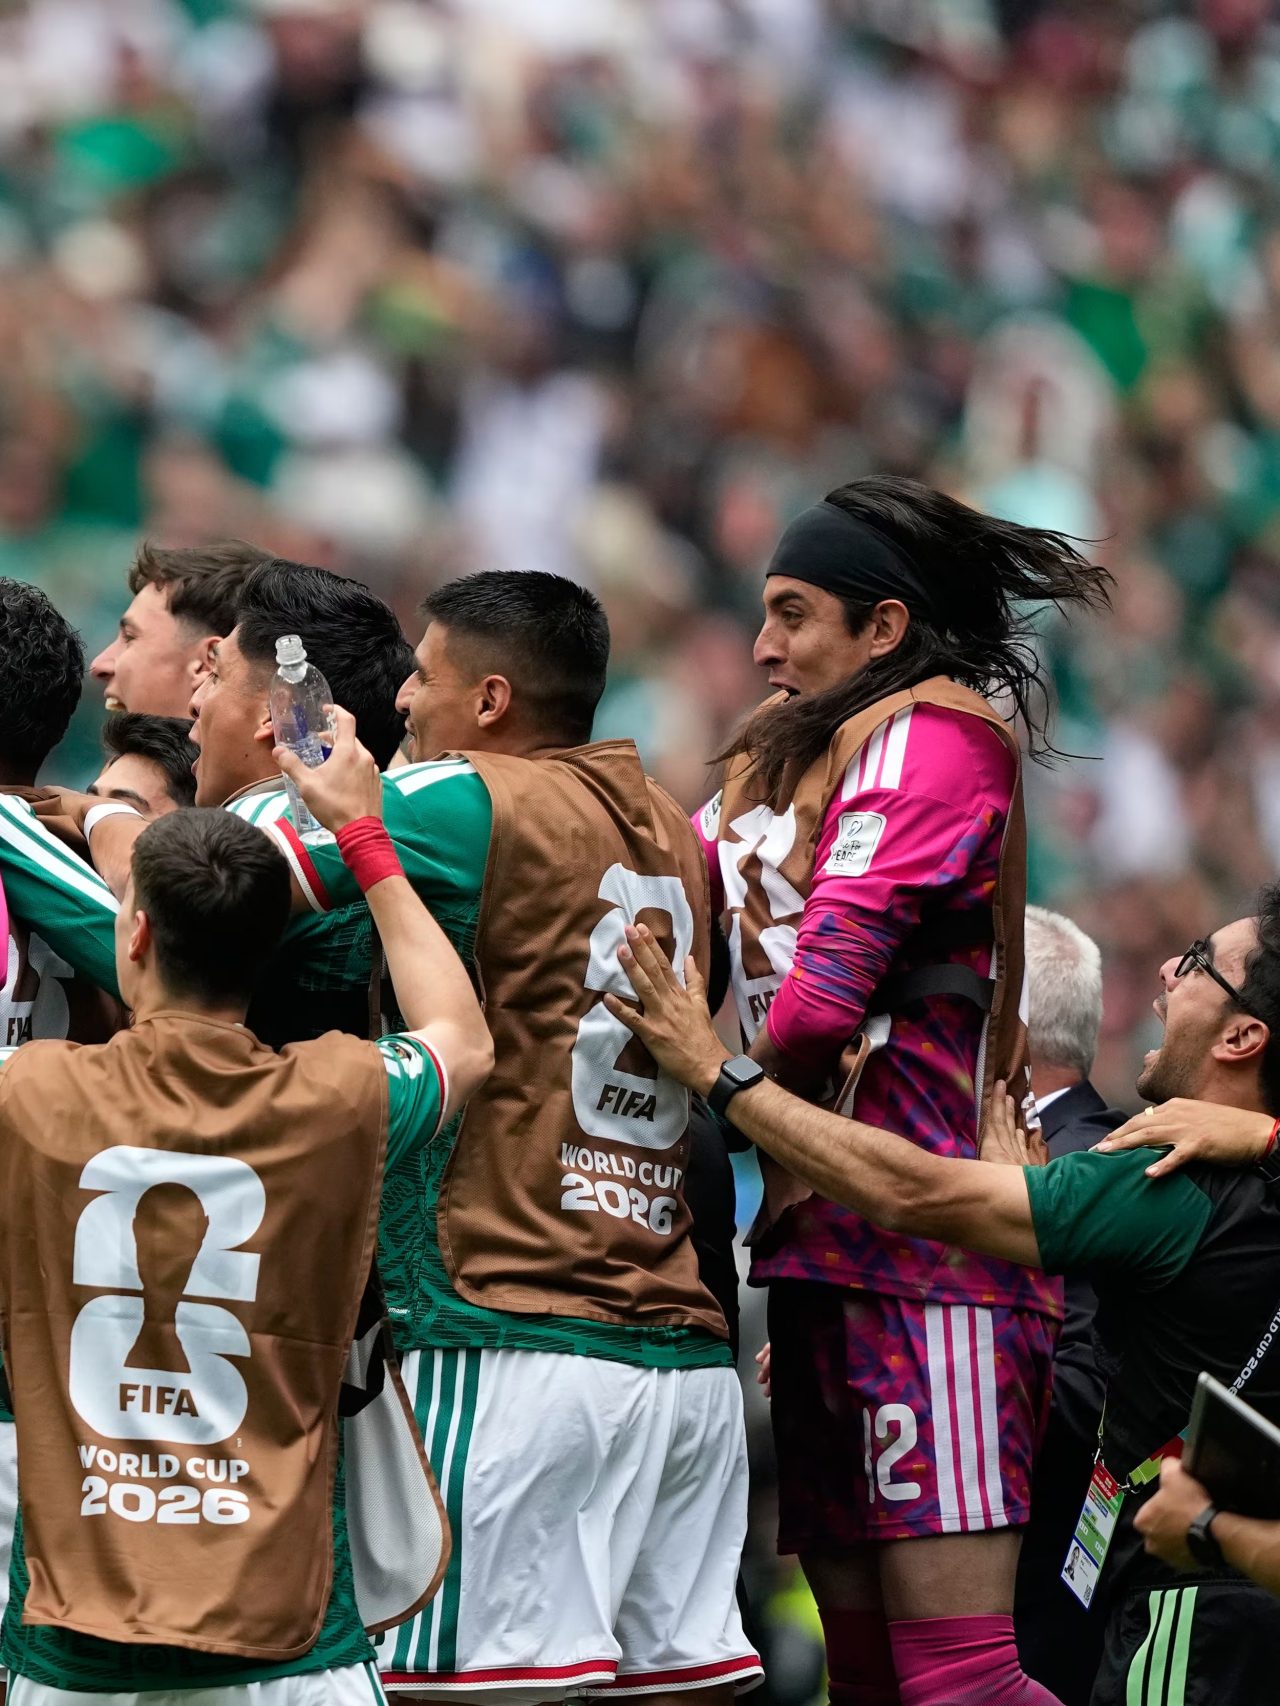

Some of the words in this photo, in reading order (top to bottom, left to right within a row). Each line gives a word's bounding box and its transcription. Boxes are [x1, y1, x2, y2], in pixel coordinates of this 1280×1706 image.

[596, 1084, 657, 1122] FIFA
[561, 1143, 636, 1179] WORLD
[639, 1162, 683, 1190] CUP
[561, 1173, 677, 1235] 2026
[1256, 1333, 1272, 1358] CUP
[120, 1383, 199, 1417] FIFA
[78, 1445, 180, 1478] WORLD
[186, 1457, 250, 1483] CUP
[81, 1476, 250, 1525] 2026
